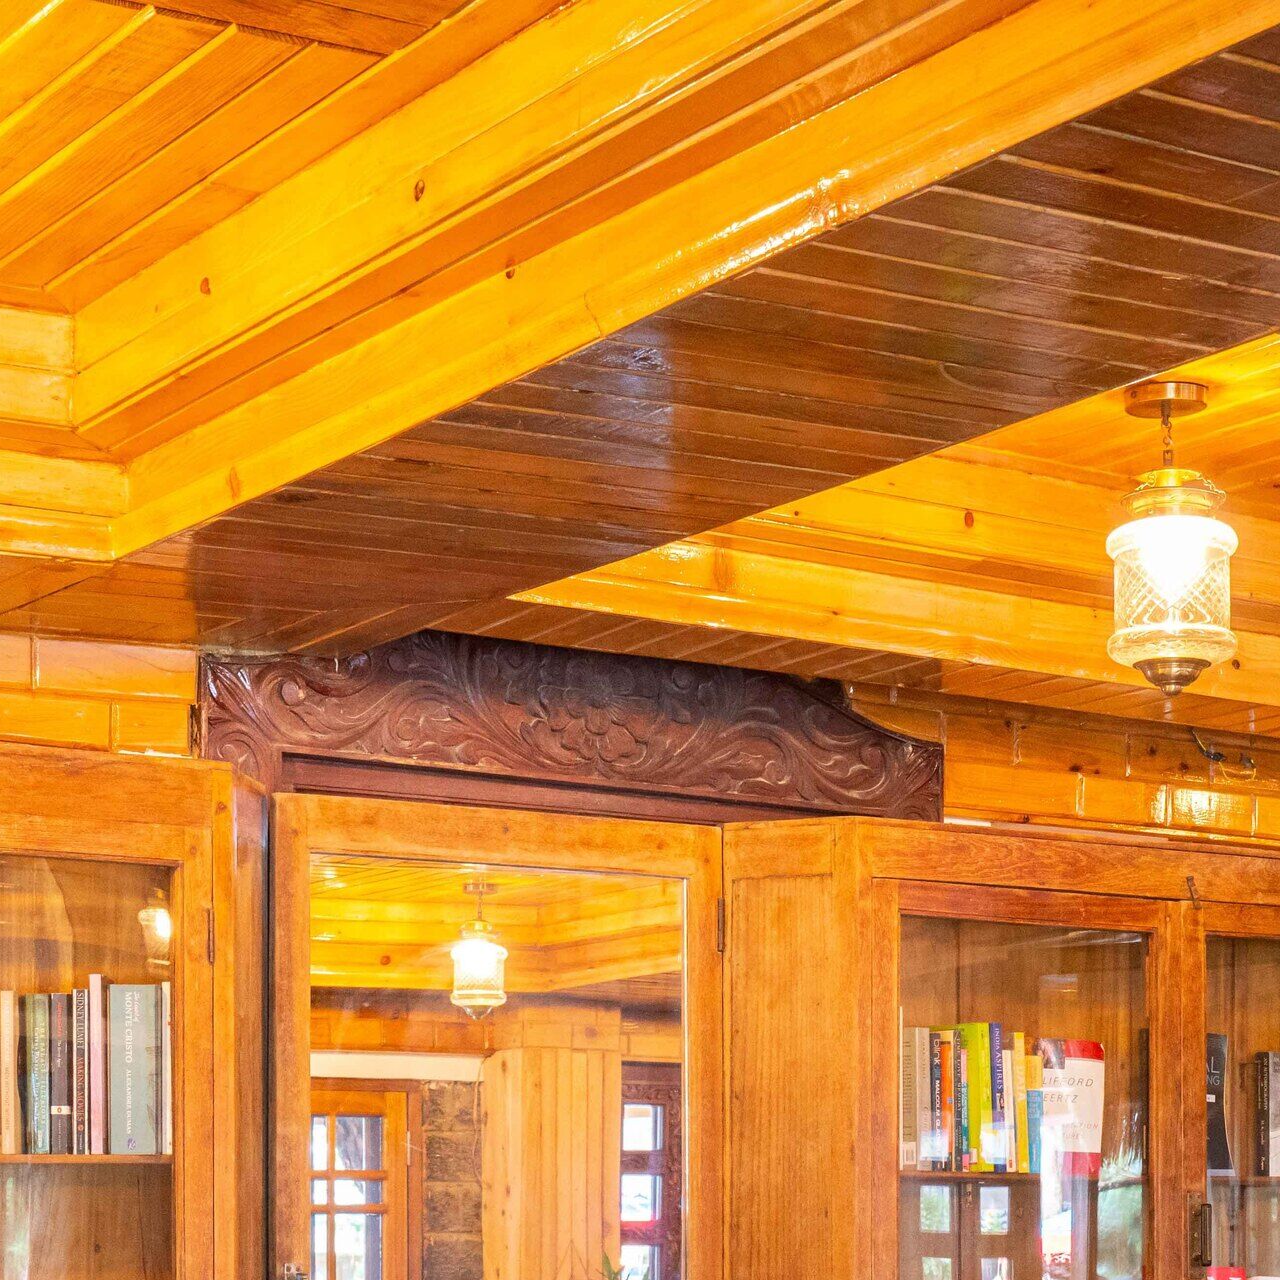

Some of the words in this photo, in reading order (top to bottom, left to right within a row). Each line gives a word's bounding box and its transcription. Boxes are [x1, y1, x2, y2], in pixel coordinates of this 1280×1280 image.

[76, 992, 85, 1022] SIDNEY
[125, 992, 133, 1027] MONTE
[76, 1022, 85, 1050] LUMET
[125, 1028, 133, 1064] CRISTO
[993, 1027, 1001, 1050] INDIA
[932, 1038, 941, 1066] blink
[76, 1056, 85, 1088] MAKING
[995, 1051, 1004, 1091] ASPIRES
